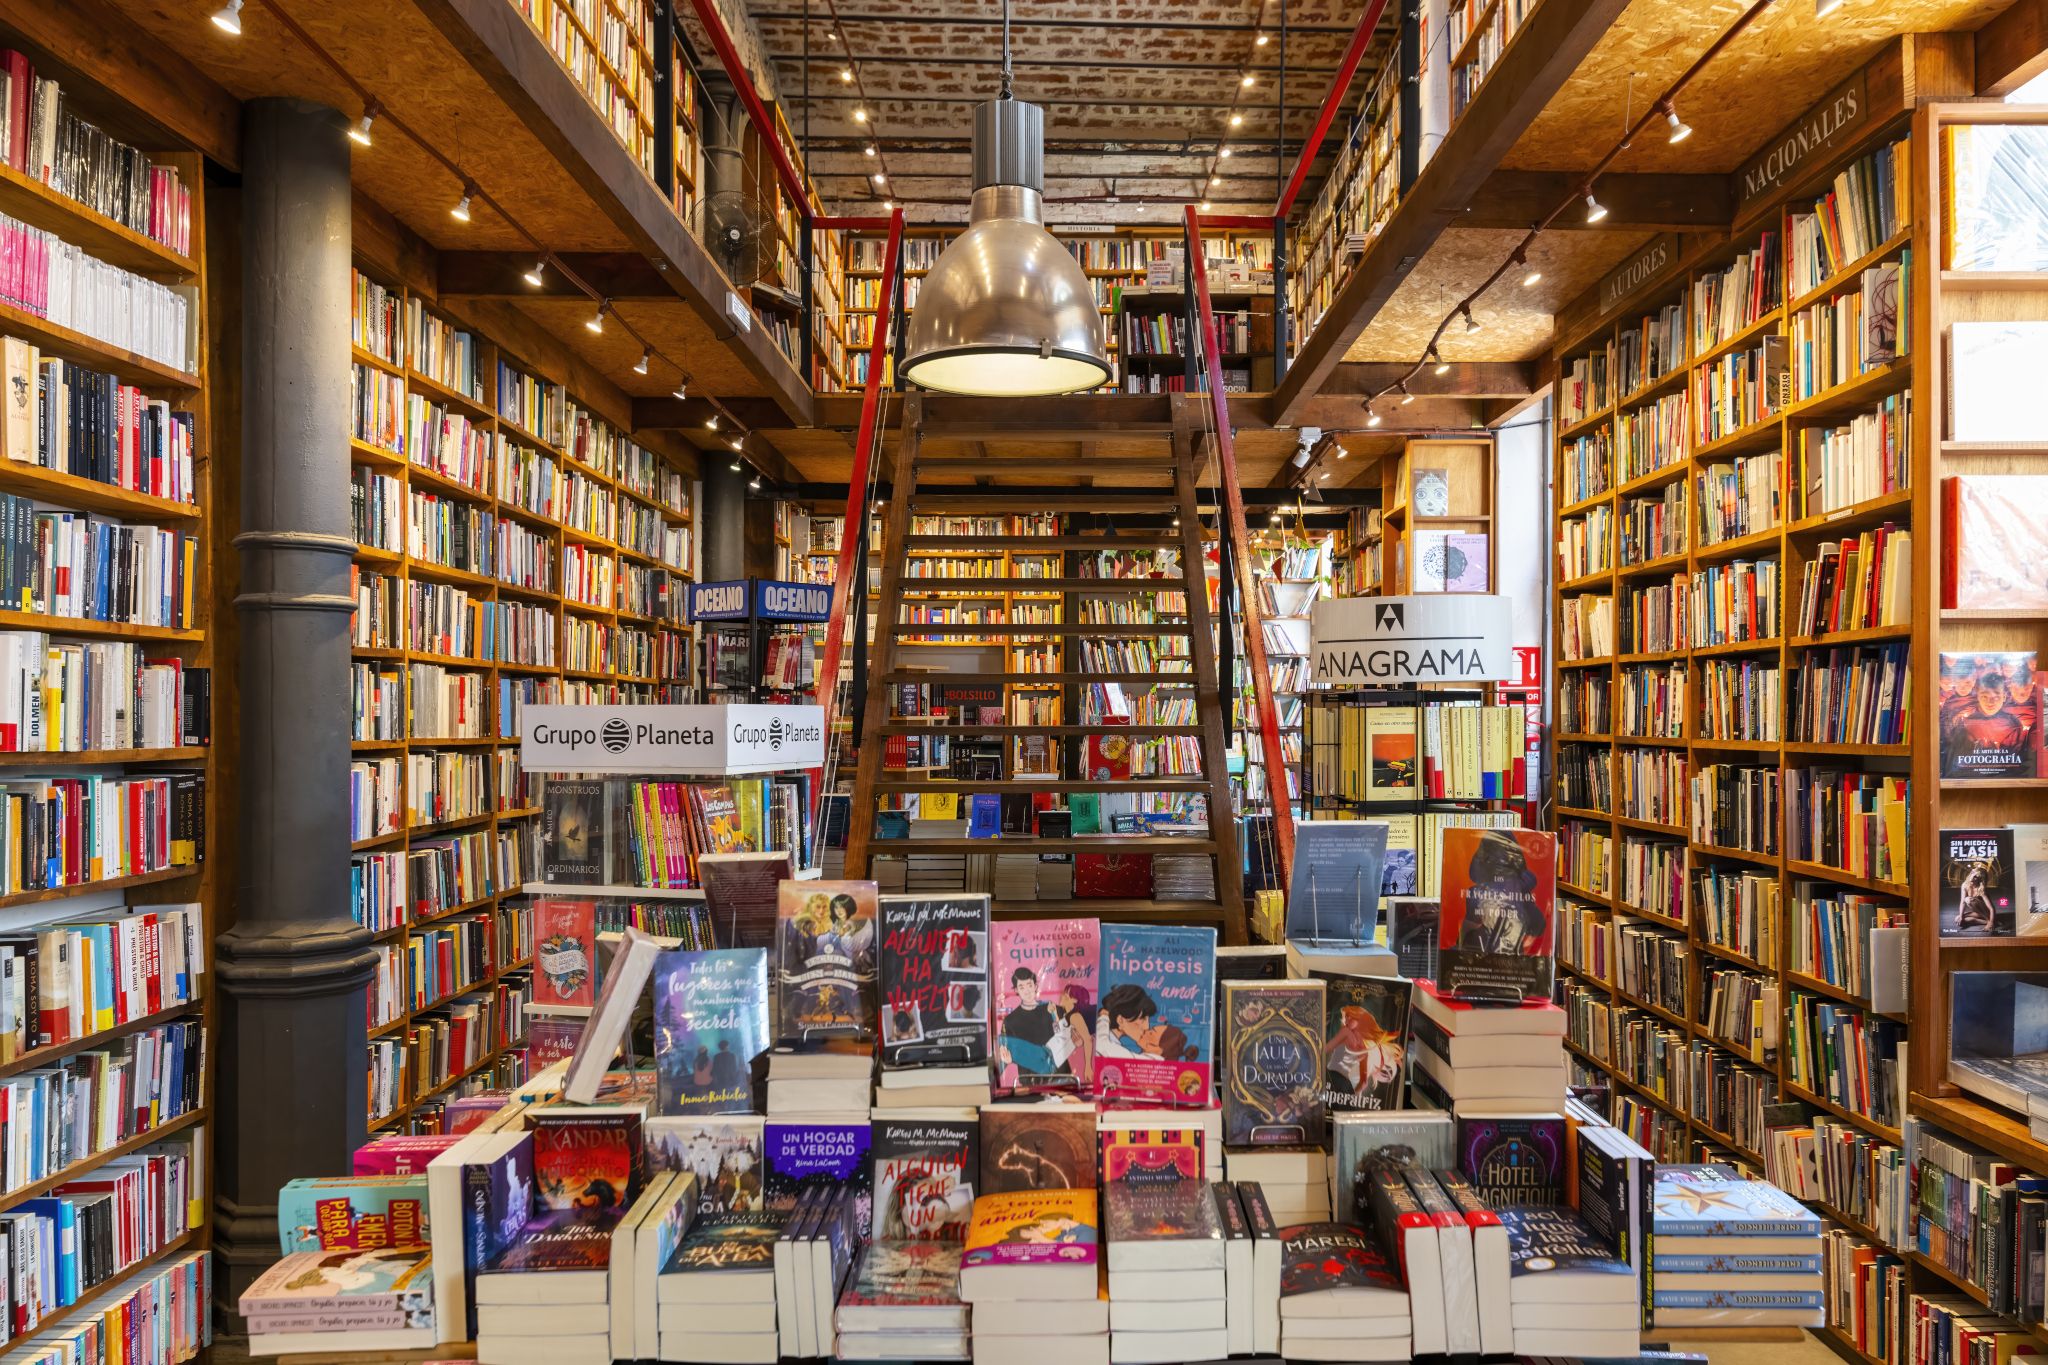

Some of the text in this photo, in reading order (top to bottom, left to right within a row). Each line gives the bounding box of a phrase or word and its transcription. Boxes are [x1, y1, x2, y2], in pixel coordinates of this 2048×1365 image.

[1745, 88, 1857, 199] NACIONALES
[1609, 242, 1668, 302] AUTORES
[694, 586, 744, 615] OCEANO
[765, 586, 828, 613] OCEANO
[1318, 648, 1485, 678] ANAGRAMA
[31, 695, 40, 737] DOLMEN
[533, 723, 714, 750] Grupo Planeta
[734, 722, 820, 749] Grupo Planeta
[1958, 753, 2022, 764] FOTOGRAFÍA
[547, 785, 600, 795] MONSTRUOS
[1950, 845, 1998, 857] FLASH
[547, 864, 600, 874] ORDINARIOS
[1508, 891, 1536, 902] HILOS
[1489, 908, 1519, 918] PODER
[884, 926, 969, 955] ALGUIEN
[1013, 931, 1028, 945] La
[1032, 933, 1091, 941] HAZELWOOD
[1010, 941, 1085, 963] química
[1121, 939, 1136, 954] La
[1141, 947, 1203, 956] HAZELWOOD
[690, 959, 728, 975] Todos los
[903, 957, 931, 982] HA
[1058, 965, 1094, 979] amor
[1110, 953, 1203, 976] hipótesis
[669, 971, 732, 1000] lugares
[1146, 976, 1199, 999] del amor
[887, 983, 966, 1013] VUELTO
[30, 1017, 37, 1033] YO
[686, 1008, 744, 1032] secreto
[553, 1035, 575, 1050] arte
[1268, 1035, 1288, 1044] UNA
[546, 1050, 560, 1058] ser
[1254, 1042, 1301, 1064] JAULA
[1243, 1066, 1312, 1088] DORADOS
[782, 1132, 855, 1143] UN HOGAR
[913, 1128, 924, 1138] M.
[1362, 1125, 1428, 1135] ERIN BEATY
[535, 1127, 628, 1151] SKANDAR
[782, 1144, 855, 1156] DE VERDAD
[882, 1145, 968, 1185] ALGUIEN
[1489, 1163, 1539, 1186] HOTEL
[895, 1175, 951, 1208] TIENE
[329, 1200, 350, 1238] PARA
[910, 1205, 935, 1227] UN
[1522, 1222, 1588, 1237] luna
[1660, 1223, 1703, 1231] CAMILA SILVA
[1734, 1223, 1802, 1231] ENTRE SILENCIOS
[525, 1232, 612, 1244] DARKENIN
[1286, 1236, 1366, 1252] MARESI
[1517, 1232, 1579, 1248] y las
[690, 1244, 770, 1256] BUSCA
[695, 1252, 766, 1267] ALBA
[1660, 1260, 1703, 1268] CAMILA SILVA
[1734, 1260, 1802, 1268] ENTRE SILENCIOS
[1660, 1296, 1703, 1304] CAMILA SILVA
[1734, 1296, 1802, 1304] ENTRE SILENCIOS
